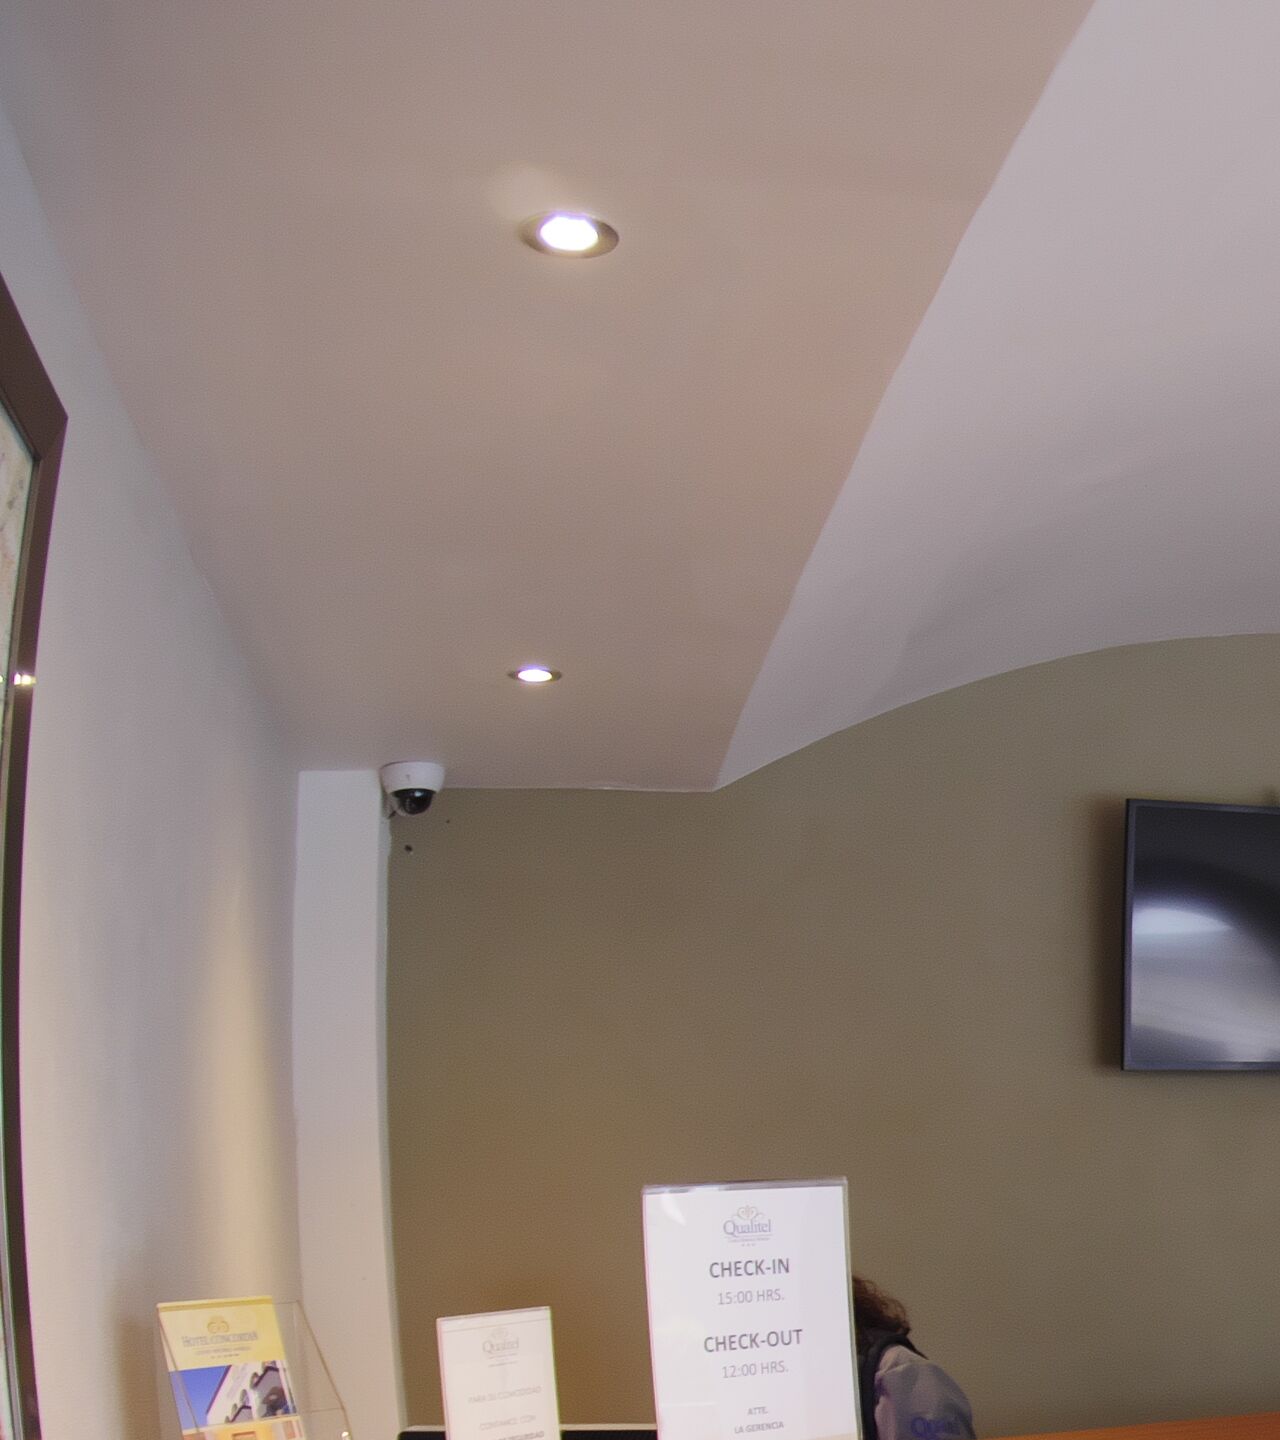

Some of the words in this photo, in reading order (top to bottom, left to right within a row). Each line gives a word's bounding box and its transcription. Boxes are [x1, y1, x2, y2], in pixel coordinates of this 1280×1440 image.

[722, 1218, 772, 1238] Qualitel
[709, 1258, 790, 1278] CHECK-IN
[718, 1289, 754, 1306] 15:00
[756, 1288, 785, 1303] HRS.
[703, 1329, 803, 1353] CHECK-OUT
[721, 1363, 757, 1379] 12:00
[760, 1360, 789, 1375] HRS.
[734, 1425, 744, 1434] LA
[745, 1421, 785, 1433] GERENCIA
